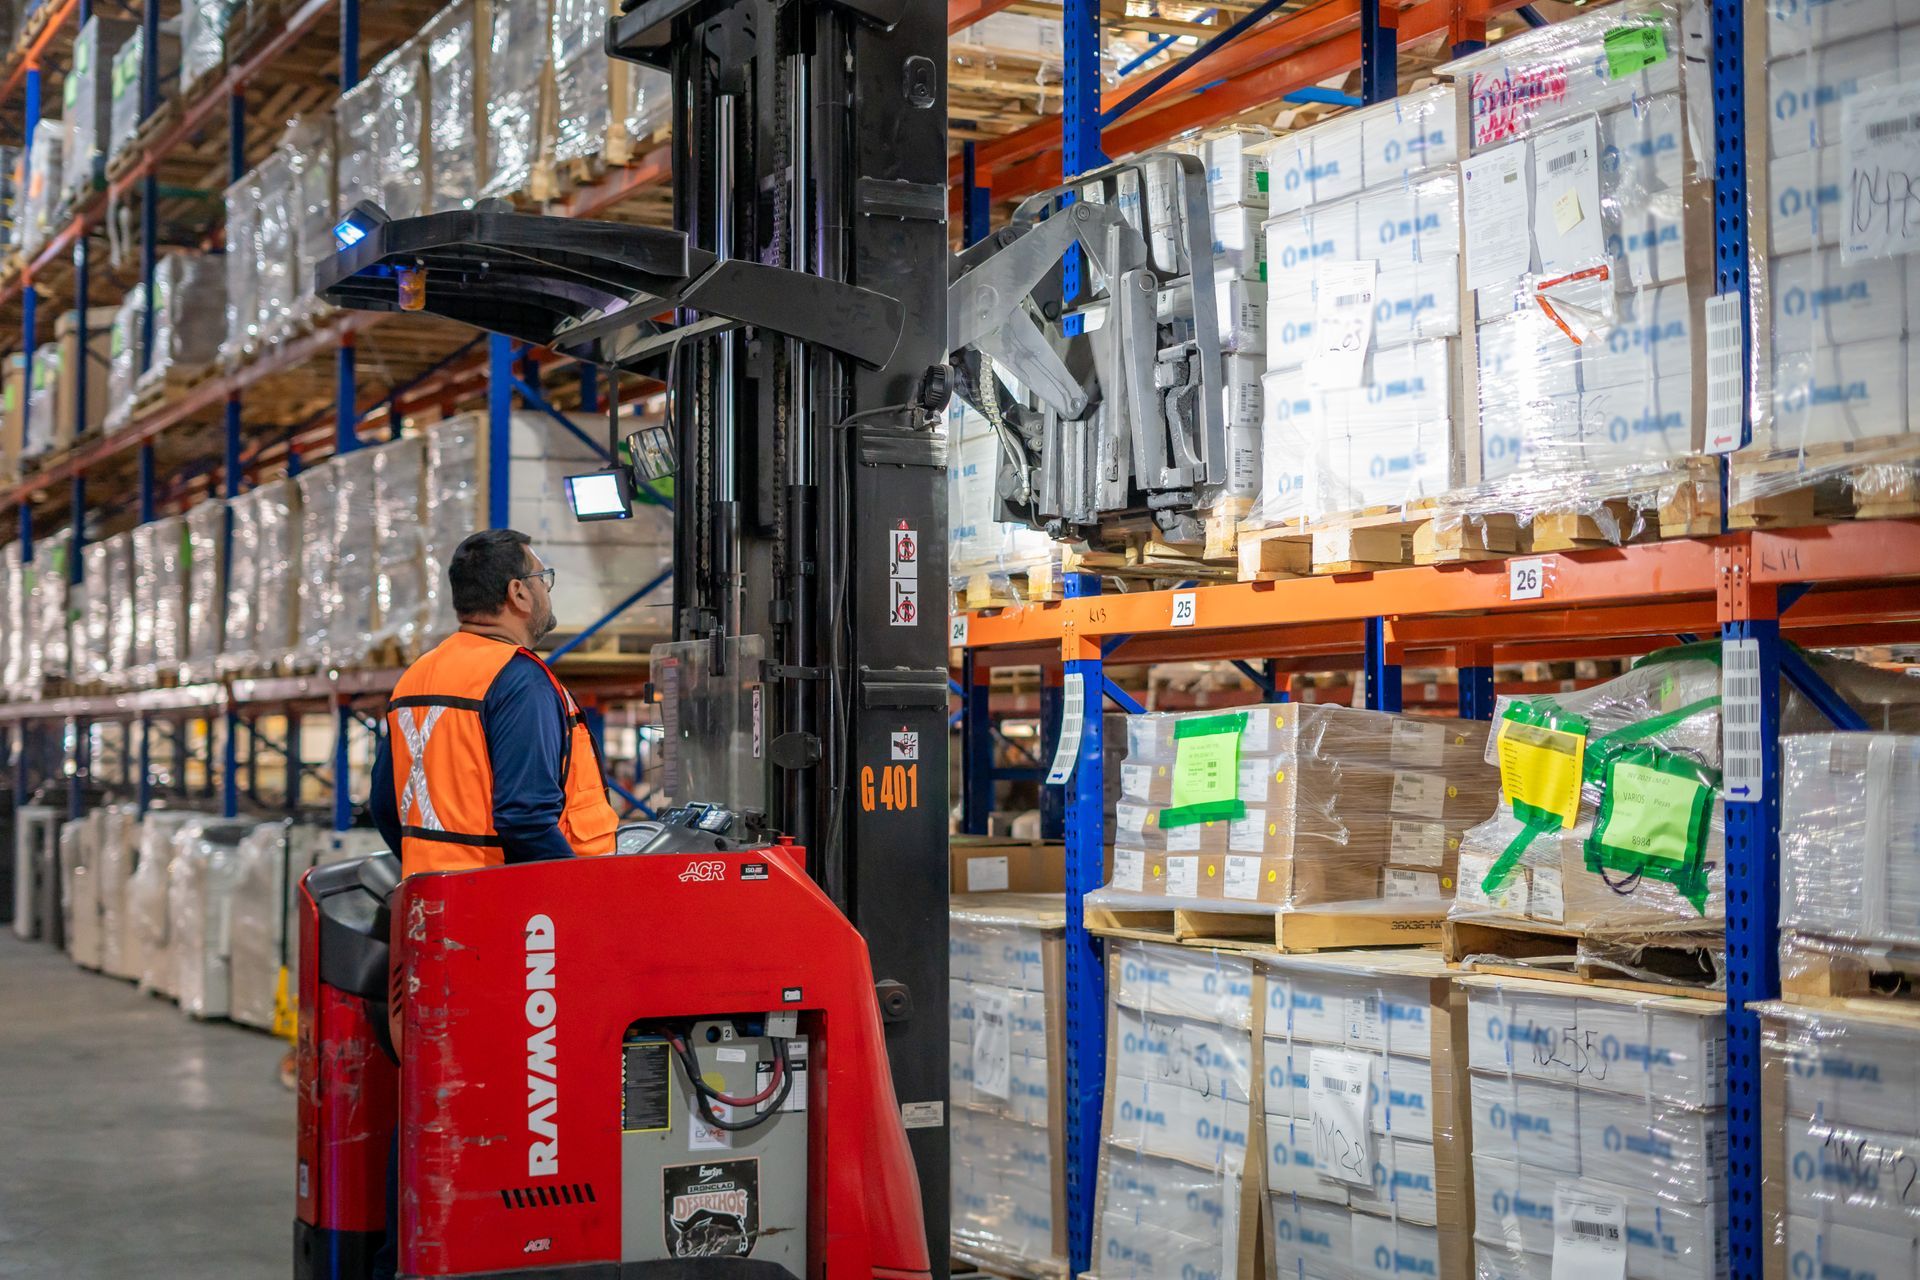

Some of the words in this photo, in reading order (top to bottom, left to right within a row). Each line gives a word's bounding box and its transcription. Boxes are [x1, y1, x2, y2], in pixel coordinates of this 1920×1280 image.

[1517, 569, 1537, 590] 26
[1089, 608, 1107, 623] K13
[1176, 600, 1192, 618] 25
[952, 623, 965, 640] 24
[860, 765, 876, 812] G
[880, 763, 919, 811] 401
[678, 861, 726, 882] ACR
[724, 1029, 731, 1038] 2
[525, 914, 559, 1177] RAYMOND
[689, 1182, 733, 1192] IRONCLAD
[1608, 1228, 1619, 1239] 15
